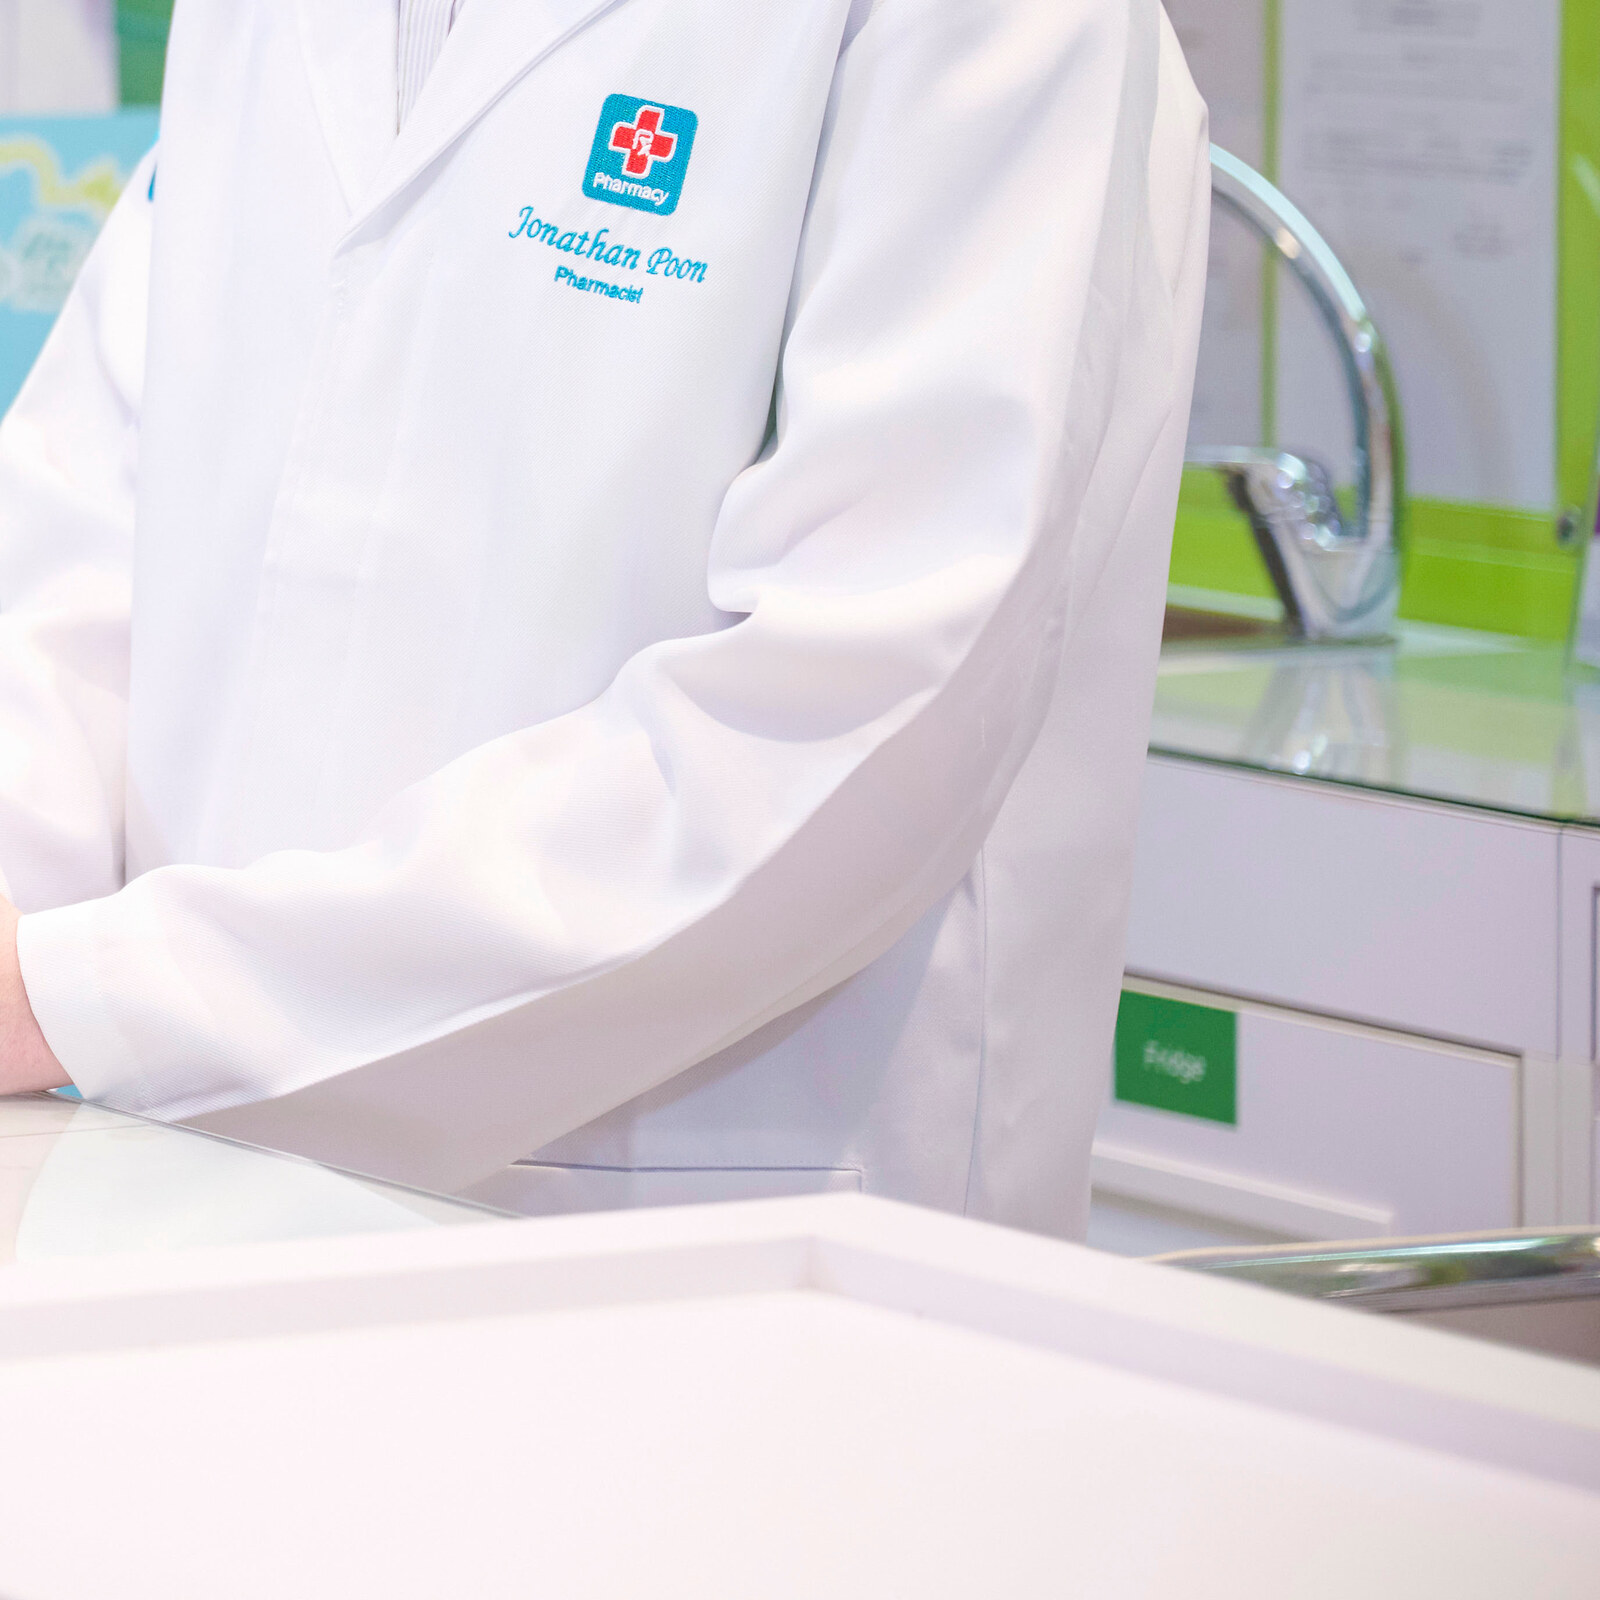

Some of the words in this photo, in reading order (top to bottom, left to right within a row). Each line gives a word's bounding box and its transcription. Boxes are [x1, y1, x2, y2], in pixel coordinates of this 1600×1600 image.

[593, 171, 669, 207] Pharmacy
[508, 206, 642, 270] Jonathan
[646, 246, 709, 283] Poon
[553, 265, 644, 304] Pharmacist
